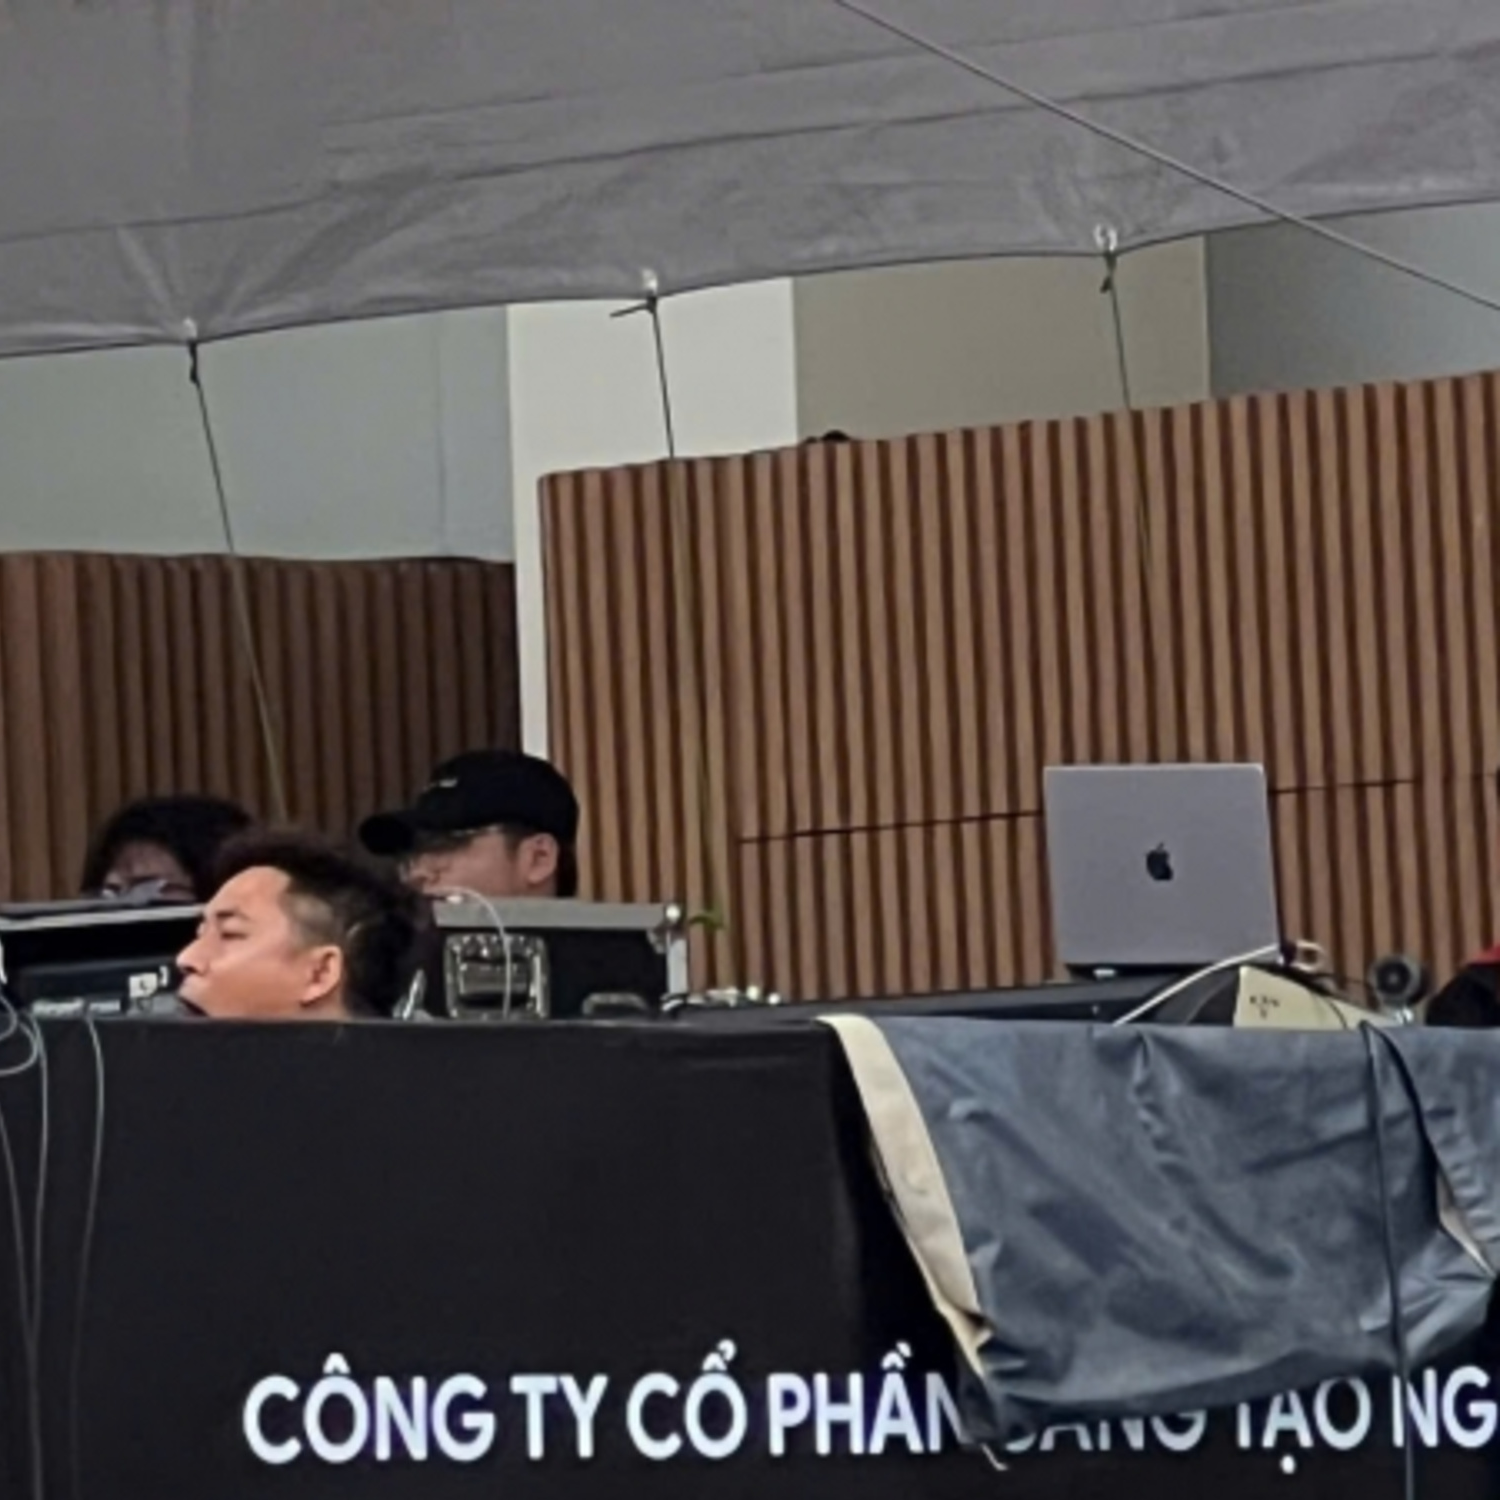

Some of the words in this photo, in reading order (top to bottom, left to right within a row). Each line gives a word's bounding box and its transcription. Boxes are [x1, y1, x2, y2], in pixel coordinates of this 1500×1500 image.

[243, 1352, 496, 1464] CÔNG
[510, 1373, 609, 1460] TY
[626, 1338, 748, 1460] CỔ
[1392, 1365, 1499, 1448] NG
